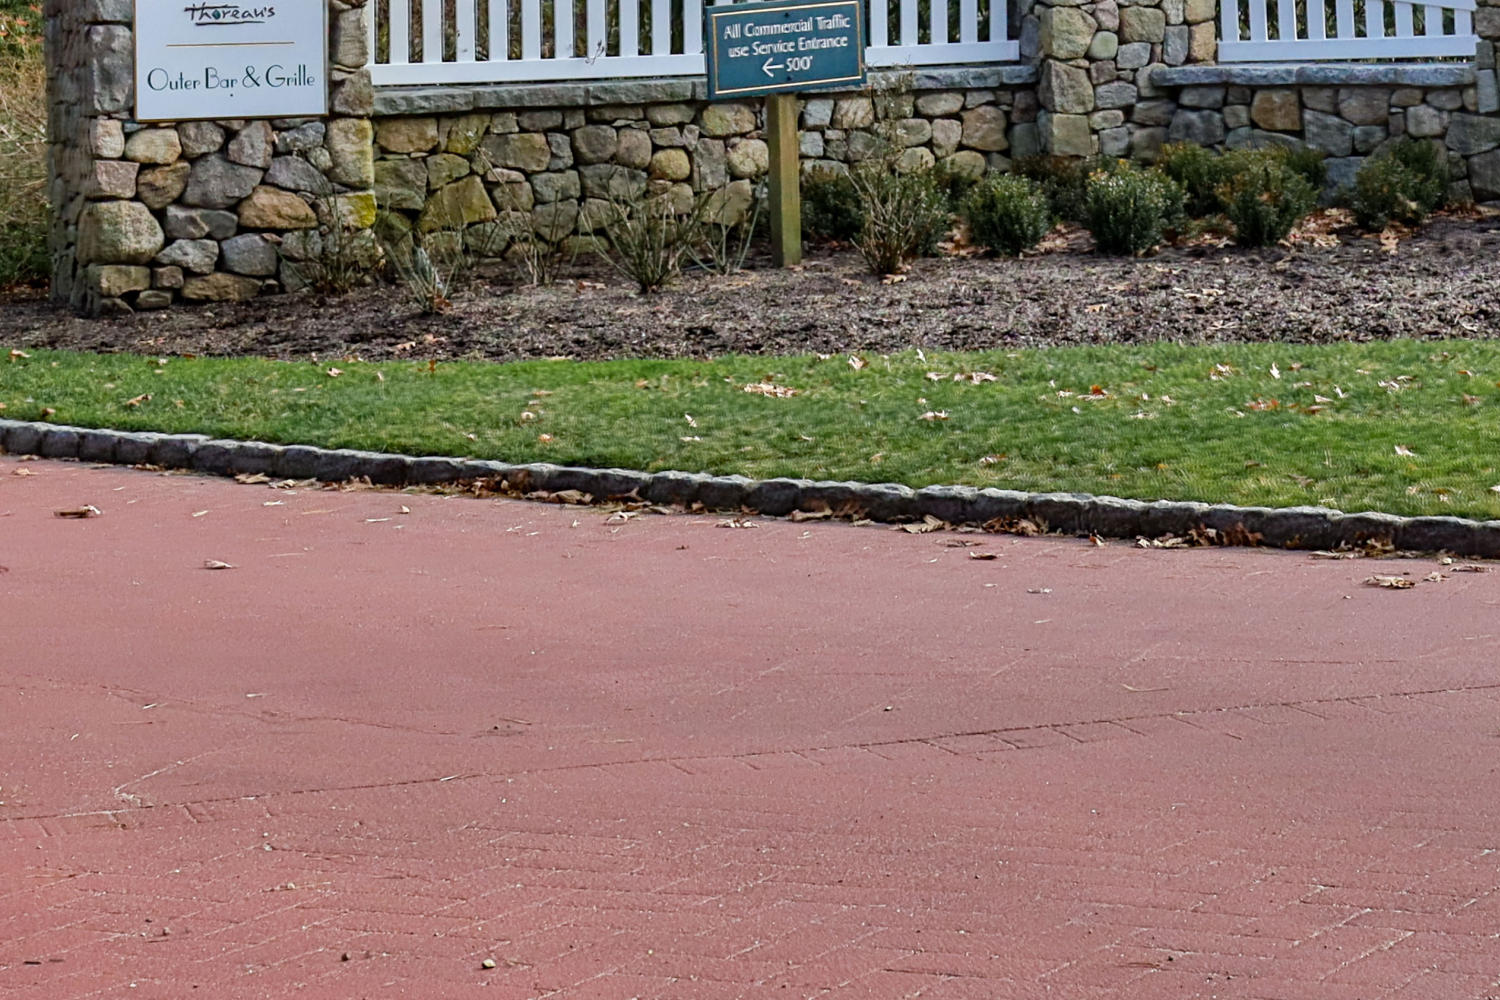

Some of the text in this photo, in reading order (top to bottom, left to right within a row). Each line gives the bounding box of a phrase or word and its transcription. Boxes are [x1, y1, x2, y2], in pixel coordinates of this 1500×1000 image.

[184, 1, 276, 22] Thoreau's
[723, 13, 851, 40] All Commercial Traffic
[728, 36, 849, 58] use Service Entrance
[147, 64, 316, 91] Outer Bar & Grille
